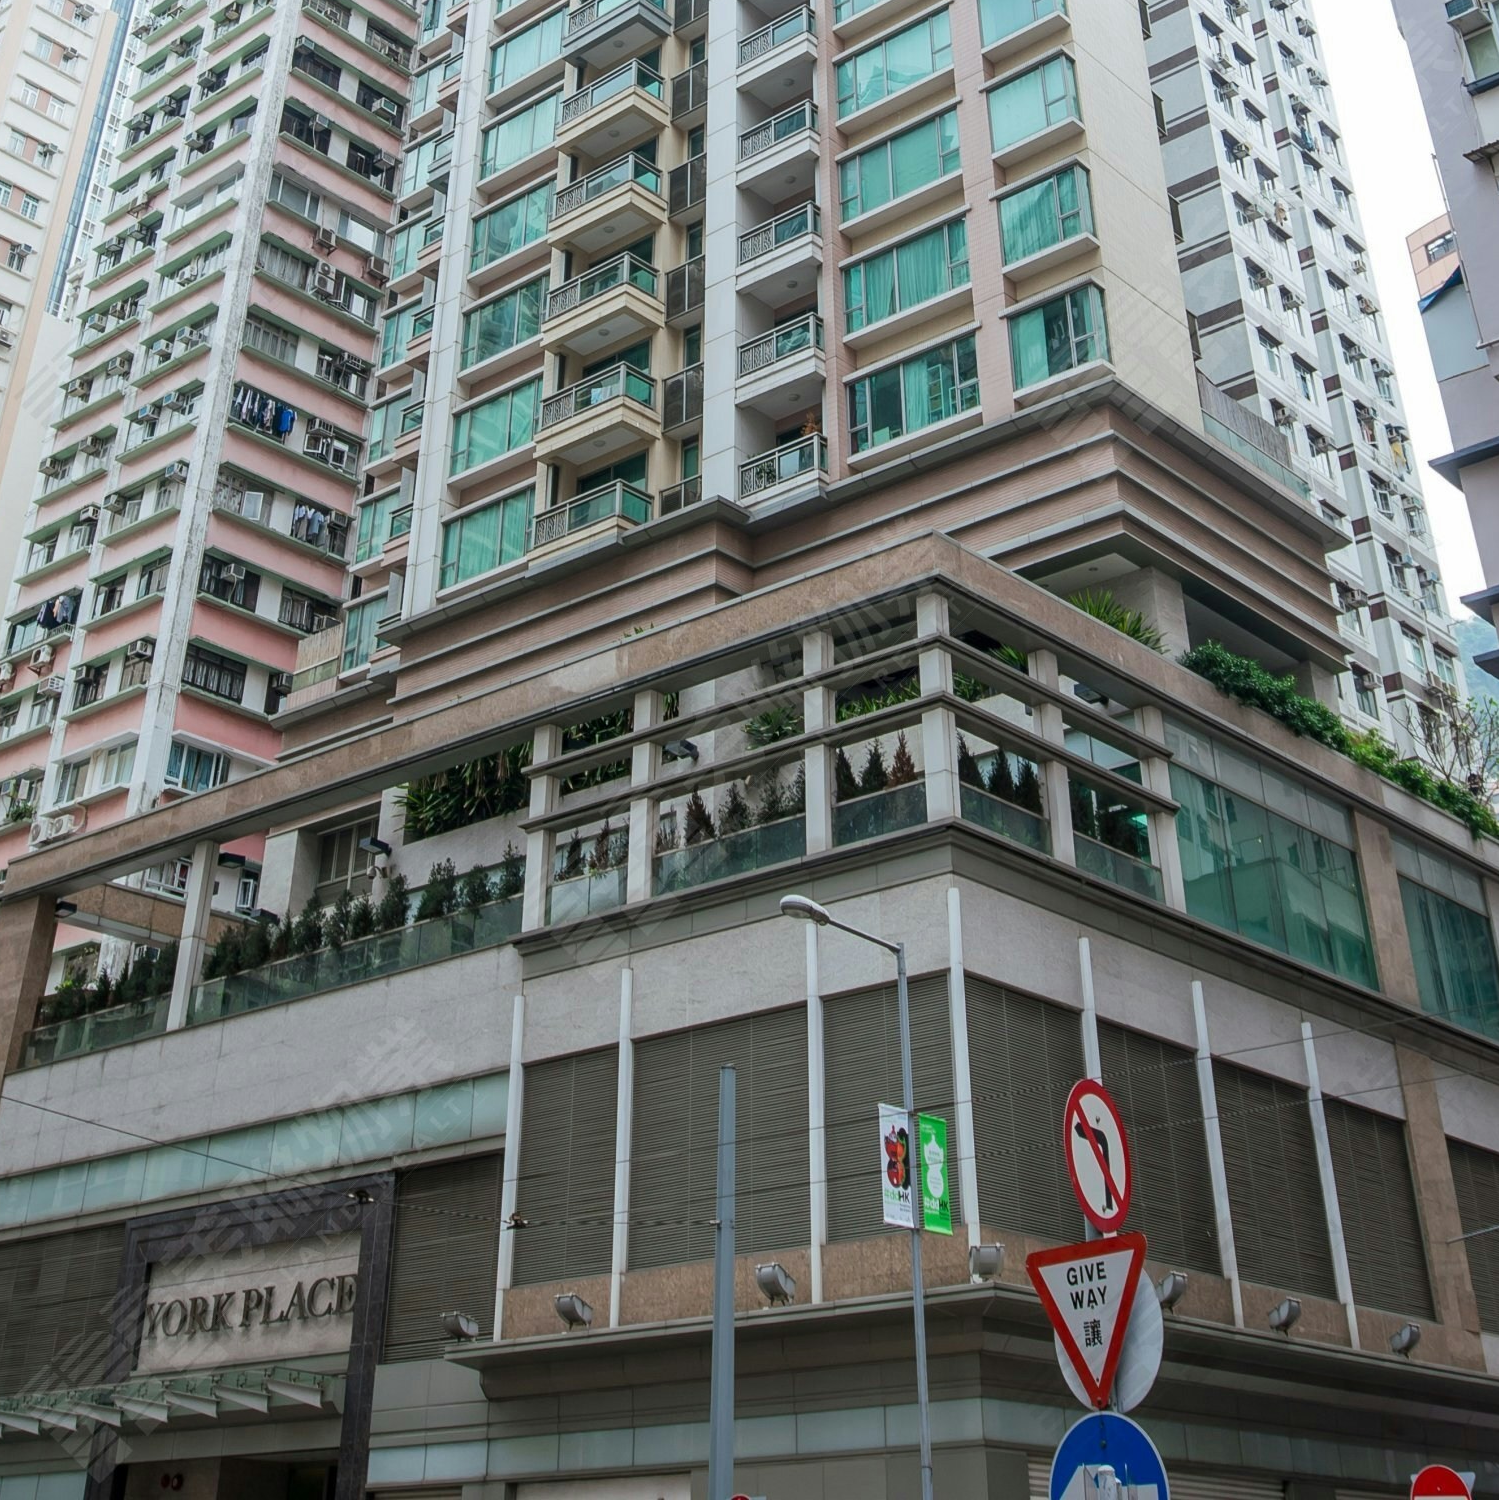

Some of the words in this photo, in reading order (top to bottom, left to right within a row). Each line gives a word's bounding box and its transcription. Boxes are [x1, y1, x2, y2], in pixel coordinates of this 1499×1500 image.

[1066, 1261, 1107, 1286] GIVE
[144, 1288, 236, 1342] YORK
[239, 1273, 359, 1330] PLACE
[1070, 1285, 1108, 1311] WAY
[1083, 1318, 1104, 1350] 讓
